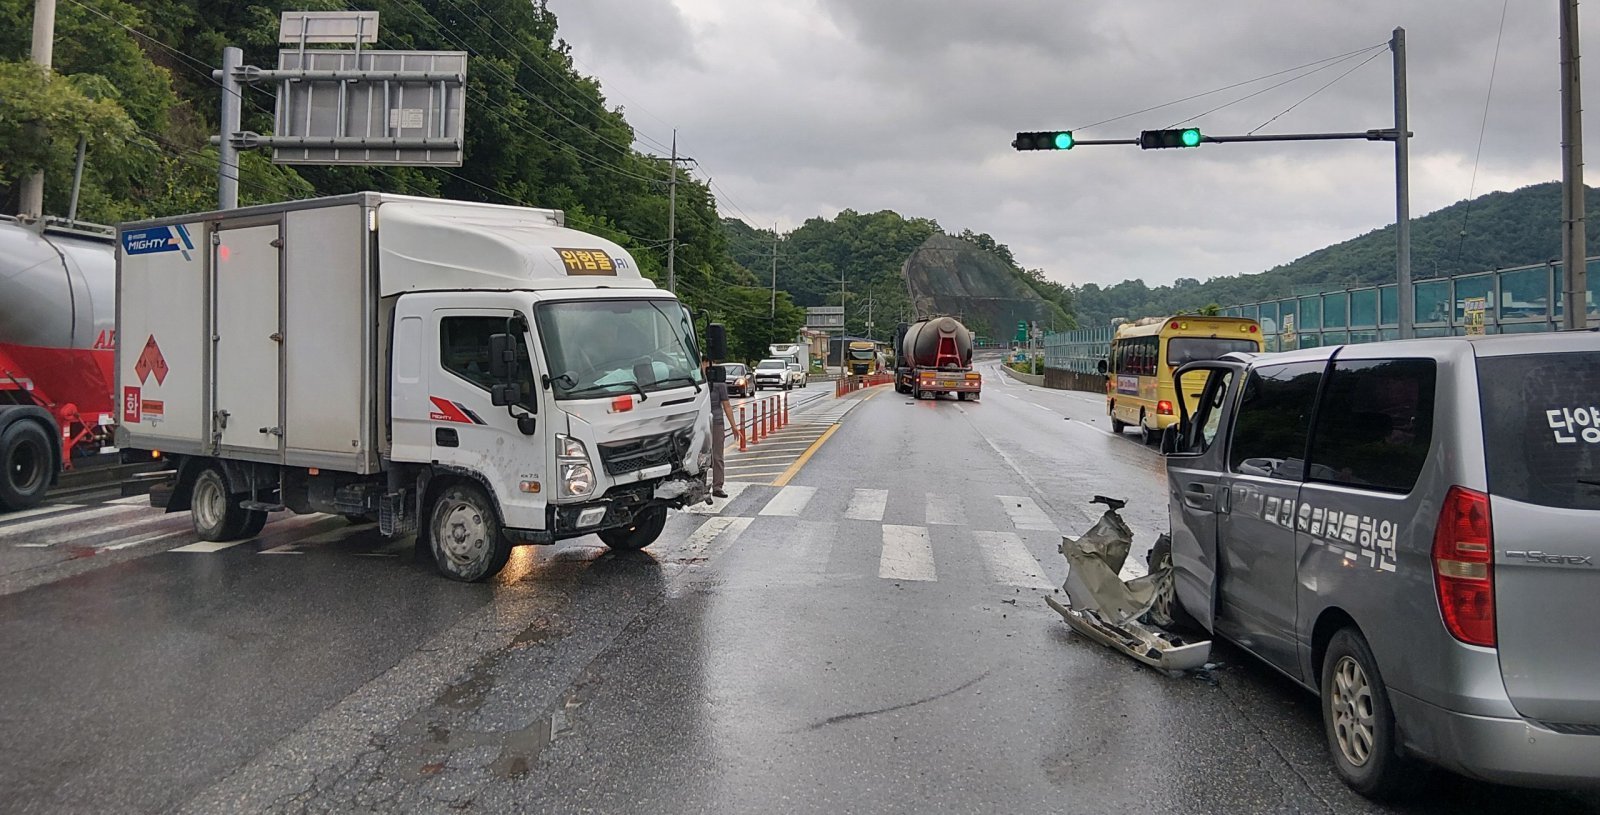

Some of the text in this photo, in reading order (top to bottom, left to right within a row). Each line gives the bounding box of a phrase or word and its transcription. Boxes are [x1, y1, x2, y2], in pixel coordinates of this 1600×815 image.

[128, 238, 166, 250] MIGHTY
[560, 250, 613, 271] 위험물
[432, 413, 452, 421] MIGHTY
